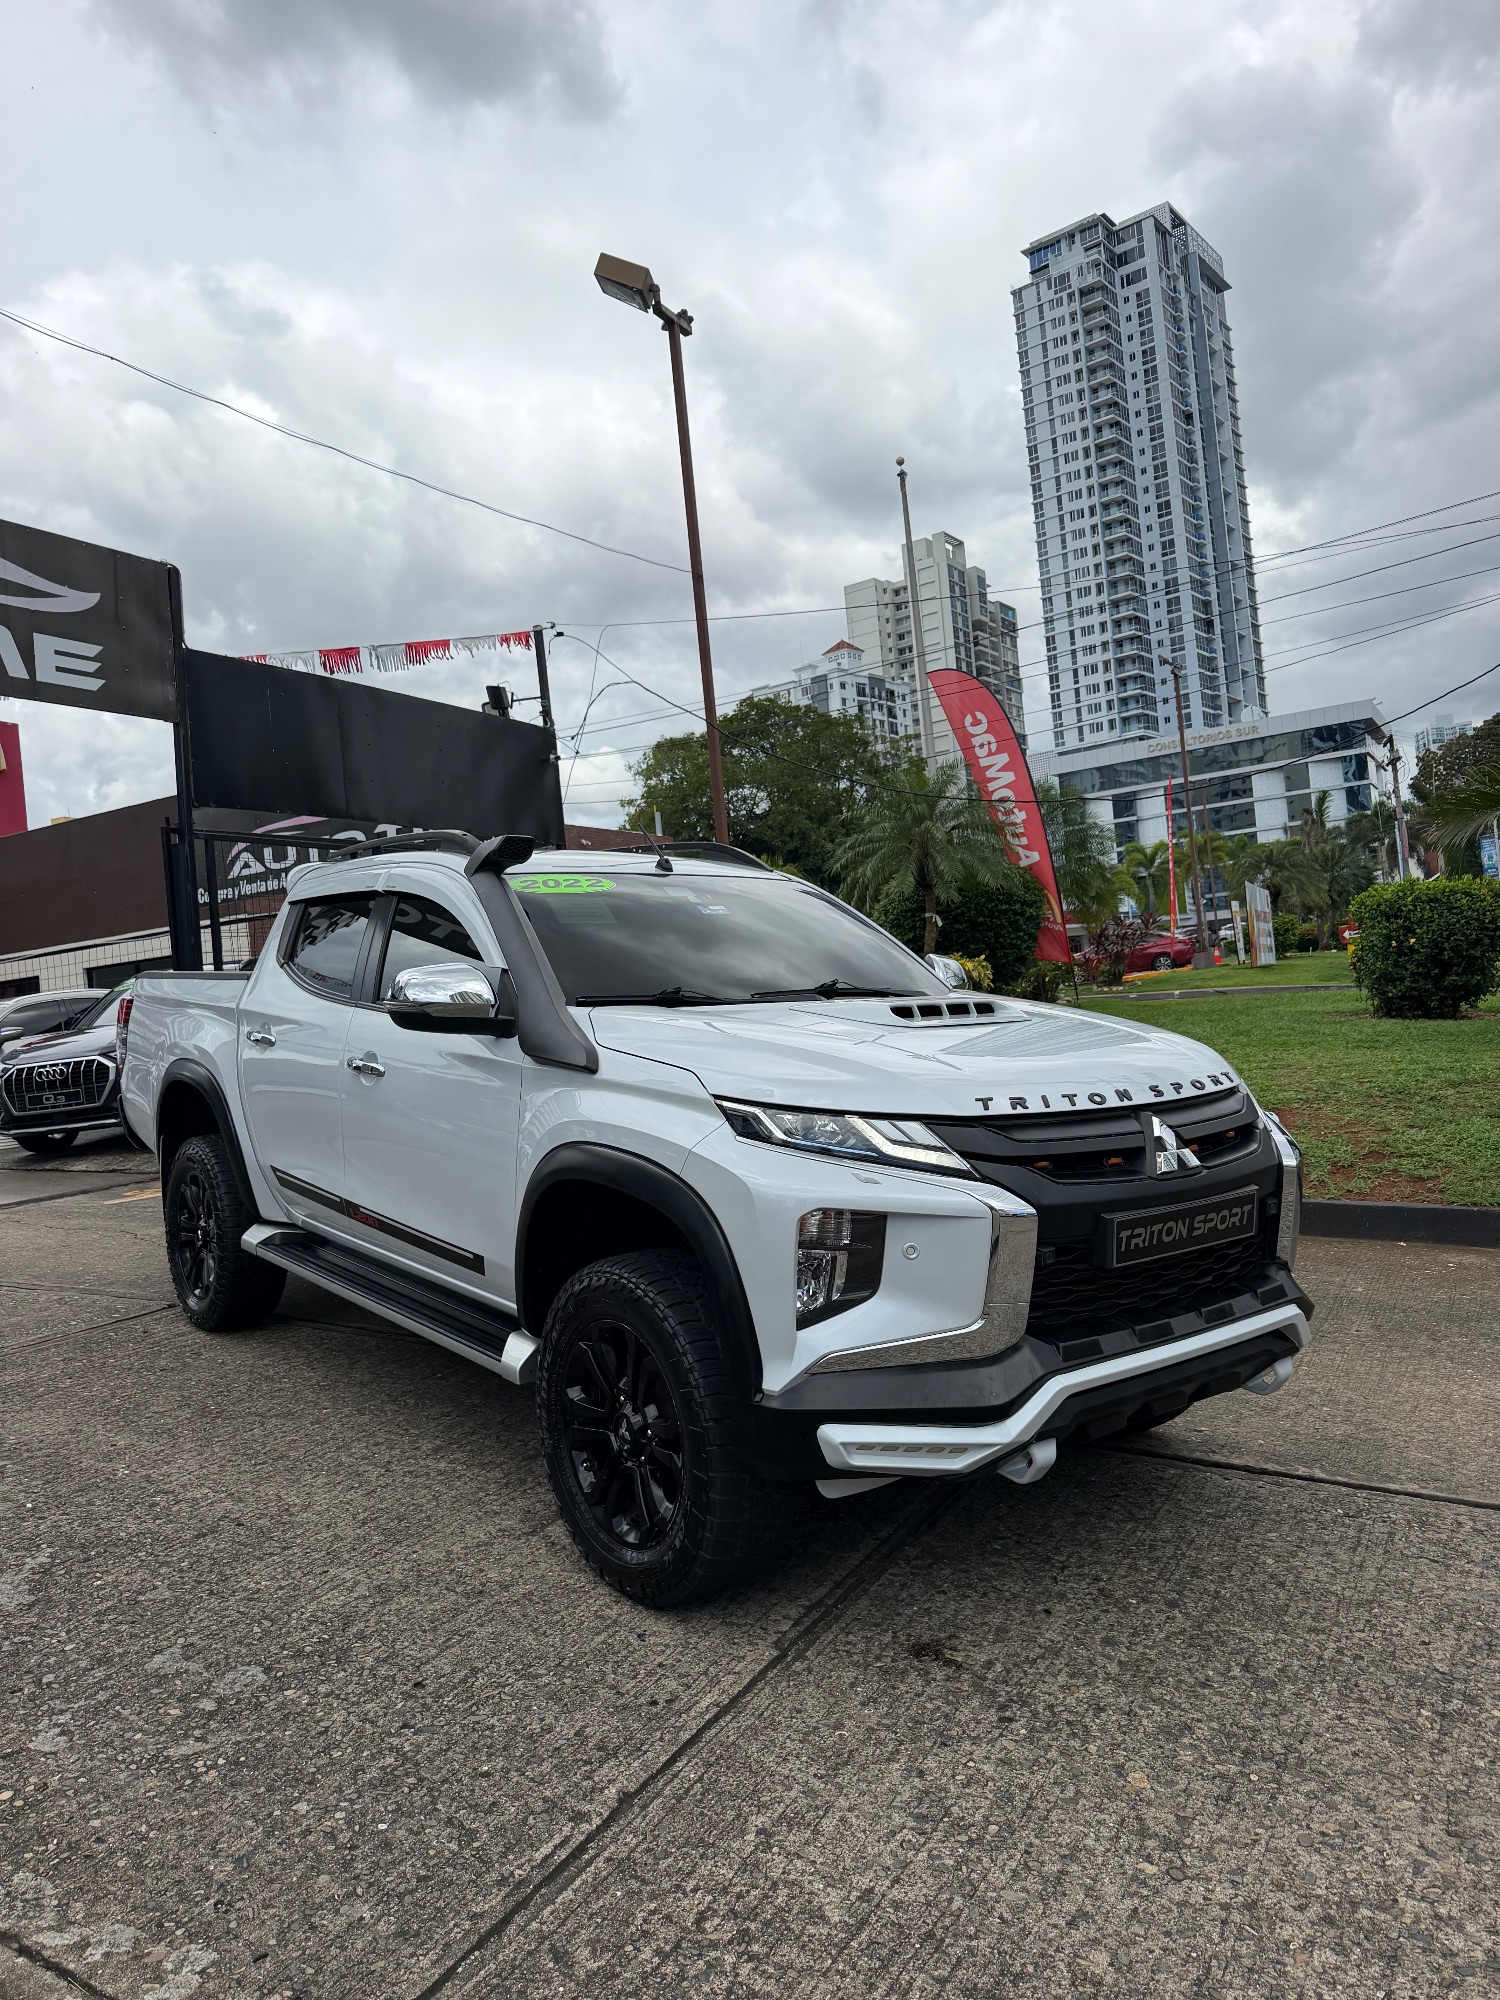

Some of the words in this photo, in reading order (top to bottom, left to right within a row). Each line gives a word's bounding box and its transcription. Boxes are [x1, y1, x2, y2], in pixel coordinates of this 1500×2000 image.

[1147, 729, 1233, 753] CONSLTORIOS
[1235, 725, 1260, 737] SUR
[197, 886, 234, 904] Copra
[239, 879, 267, 896] Venta
[267, 875, 279, 891] de
[519, 878, 605, 890] 2022
[42, 1094, 66, 1104] Q3
[975, 1087, 1134, 1111] TRITON
[1148, 1070, 1236, 1098] SPORT
[350, 1207, 379, 1229] L200
[1118, 1217, 1190, 1252] TRITON
[1191, 1203, 1253, 1237] SPORT
